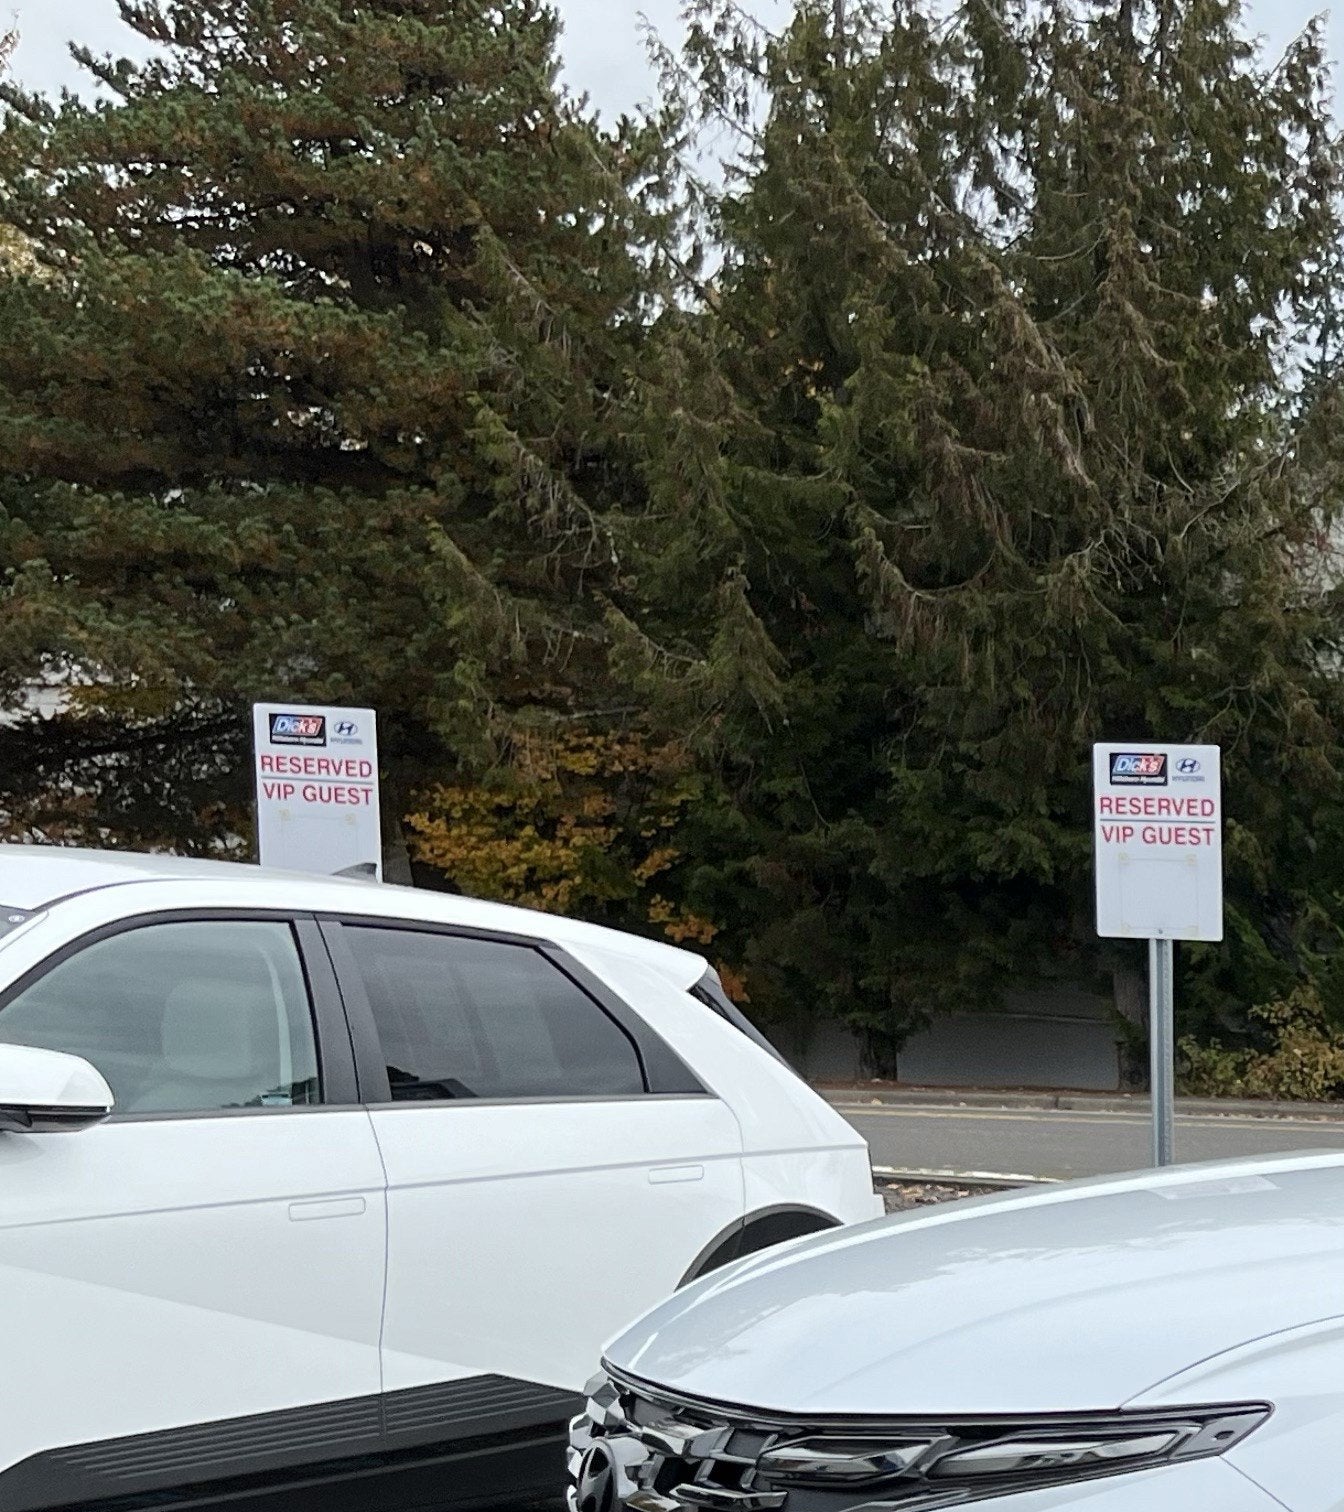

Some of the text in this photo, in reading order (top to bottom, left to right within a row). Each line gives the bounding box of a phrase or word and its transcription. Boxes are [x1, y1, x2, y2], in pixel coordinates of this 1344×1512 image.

[260, 755, 373, 778] RESERVED
[263, 783, 373, 806] VIP GUEST
[1100, 797, 1215, 817] RESERVED
[1101, 826, 1215, 846] VIP GUEST
